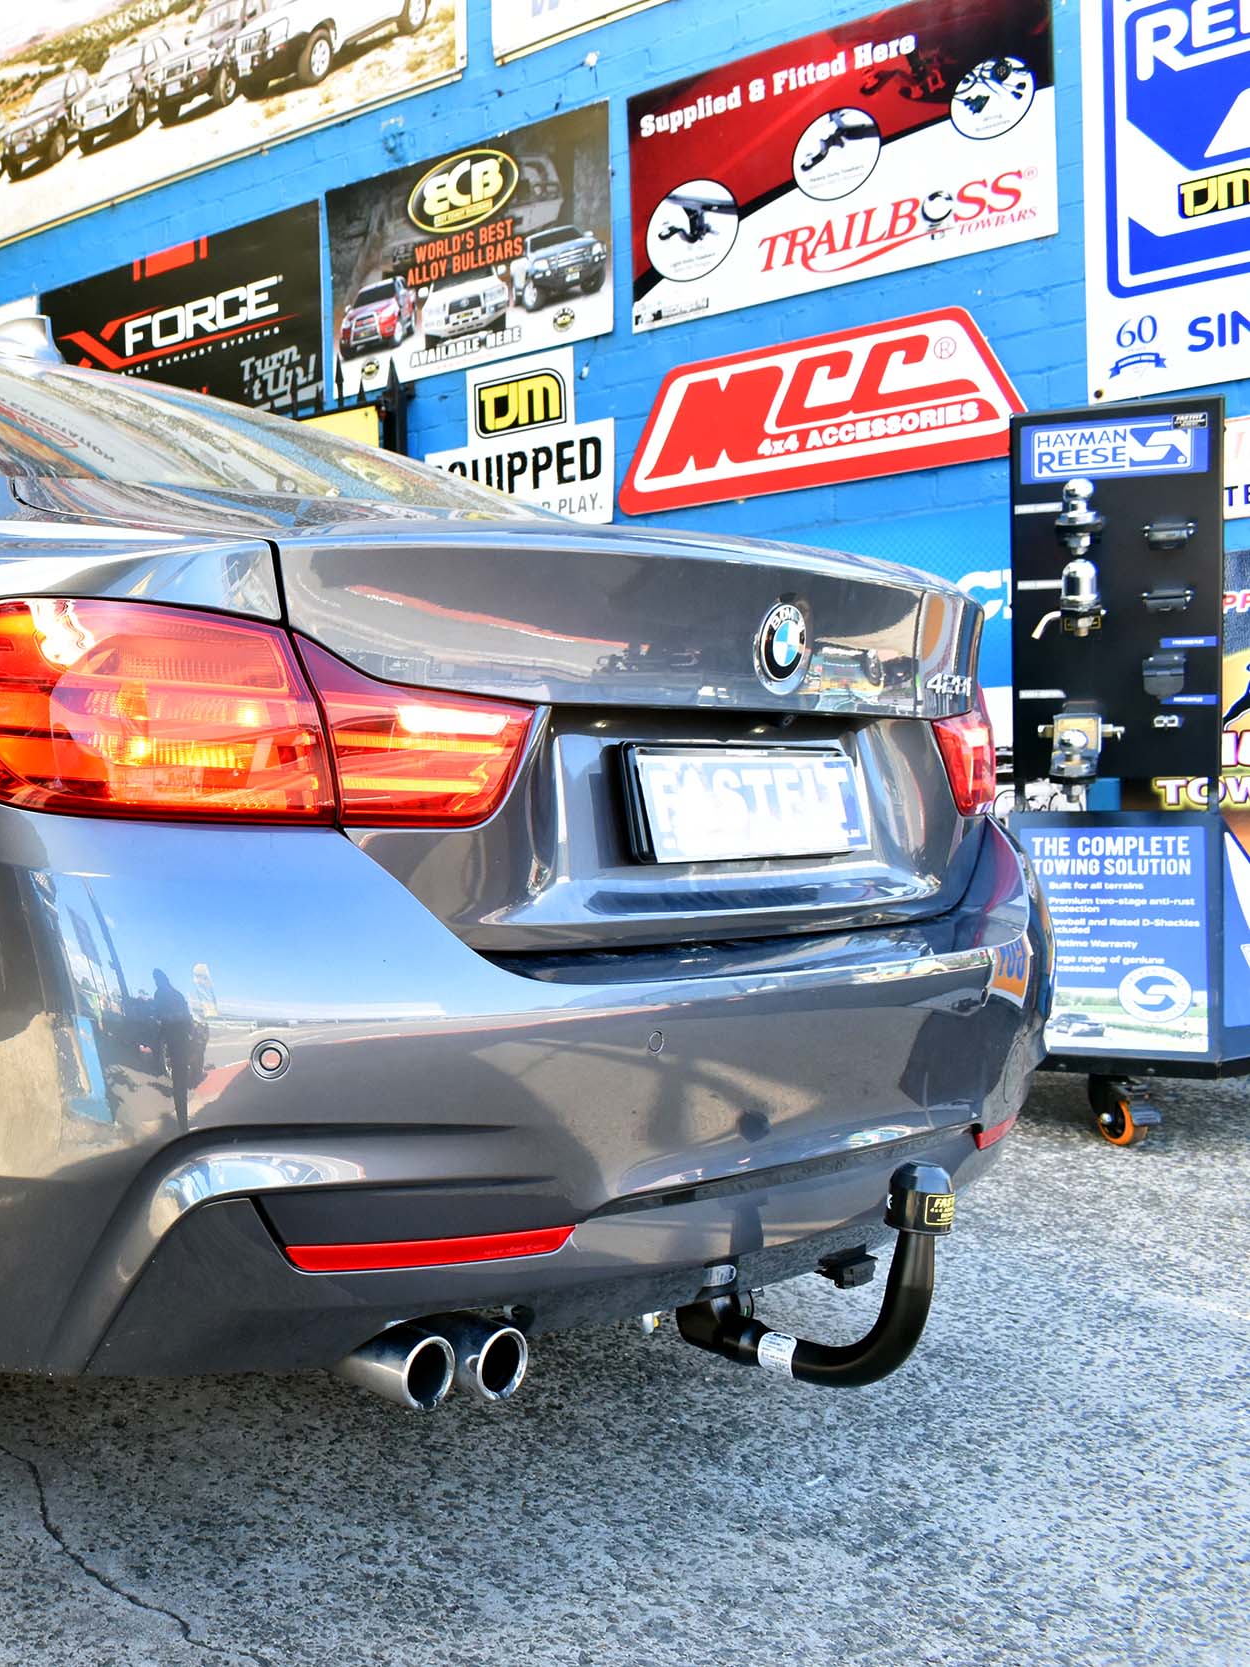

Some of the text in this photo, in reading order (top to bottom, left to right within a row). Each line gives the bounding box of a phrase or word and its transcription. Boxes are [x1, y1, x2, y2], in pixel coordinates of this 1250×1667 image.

[640, 34, 916, 138] Supplied & Fitted Here
[423, 158, 504, 215] ECB
[958, 207, 1037, 236] TOWBARS
[415, 218, 514, 264] WORLD'S BEST
[406, 236, 523, 287] ALLOY BULLBARS
[158, 326, 280, 368] EXHAUST SYSTEMS
[410, 336, 482, 368] AVAILABLE
[484, 325, 522, 349] HERE
[1116, 315, 1157, 348] 60
[240, 345, 301, 381] Turn
[644, 334, 980, 480] MCC
[757, 401, 980, 456] 4x4 ACCESSORIES
[1037, 428, 1127, 448] HAYMAN
[1037, 446, 1127, 474] REESE
[558, 492, 603, 514] PLAY.
[648, 766, 850, 836] FASTFIT
[1031, 835, 1190, 856] THE COMPLETE
[1032, 857, 1191, 875] TOWING SOLUTION
[1074, 882, 1089, 890] for
[1090, 882, 1103, 890] all
[1104, 882, 1144, 890] terrains
[1048, 897, 1195, 908] Premium two-stage anti-rust
[1088, 918, 1107, 926] and
[1110, 918, 1140, 926] Rated
[1142, 918, 1200, 928] D-Shackles
[1090, 939, 1139, 949] Warranty
[1078, 955, 1107, 965] range
[1110, 955, 1122, 964] of
